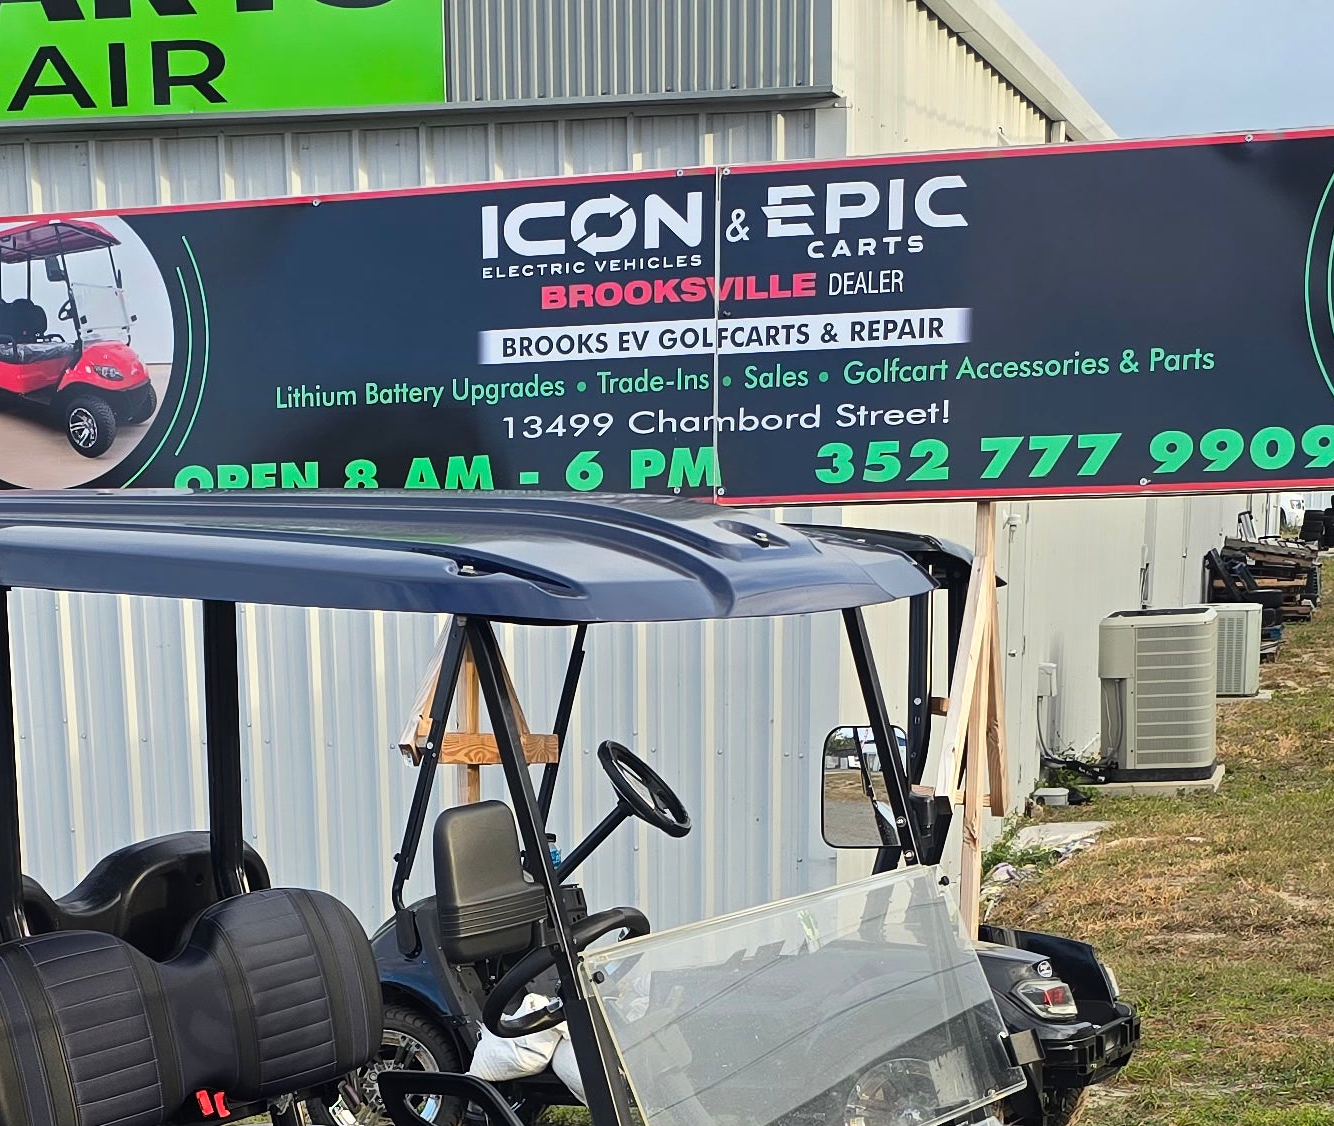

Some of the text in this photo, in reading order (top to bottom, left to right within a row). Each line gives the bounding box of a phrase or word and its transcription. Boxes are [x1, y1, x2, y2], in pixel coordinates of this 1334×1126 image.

[482, 175, 969, 260] ICON & EPIC
[482, 253, 702, 279] ELECTRIC VEHICLES
[807, 235, 925, 259] CARTS
[541, 270, 904, 310] BROOKSVILLE DEALER
[502, 316, 944, 360] BROOKS EV GOLFCARTS & REPAIR
[275, 346, 1216, 410] Lithium Battery Upgrades Trade-Ins Sales Golfcart Accessories & Parts
[502, 400, 951, 439] 13499 Chambord Street!
[344, 458, 378, 489] 8
[403, 455, 495, 490] AM
[565, 450, 605, 491] 6
[630, 446, 724, 489] PM
[814, 438, 950, 484] 352
[980, 433, 1123, 479] 777
